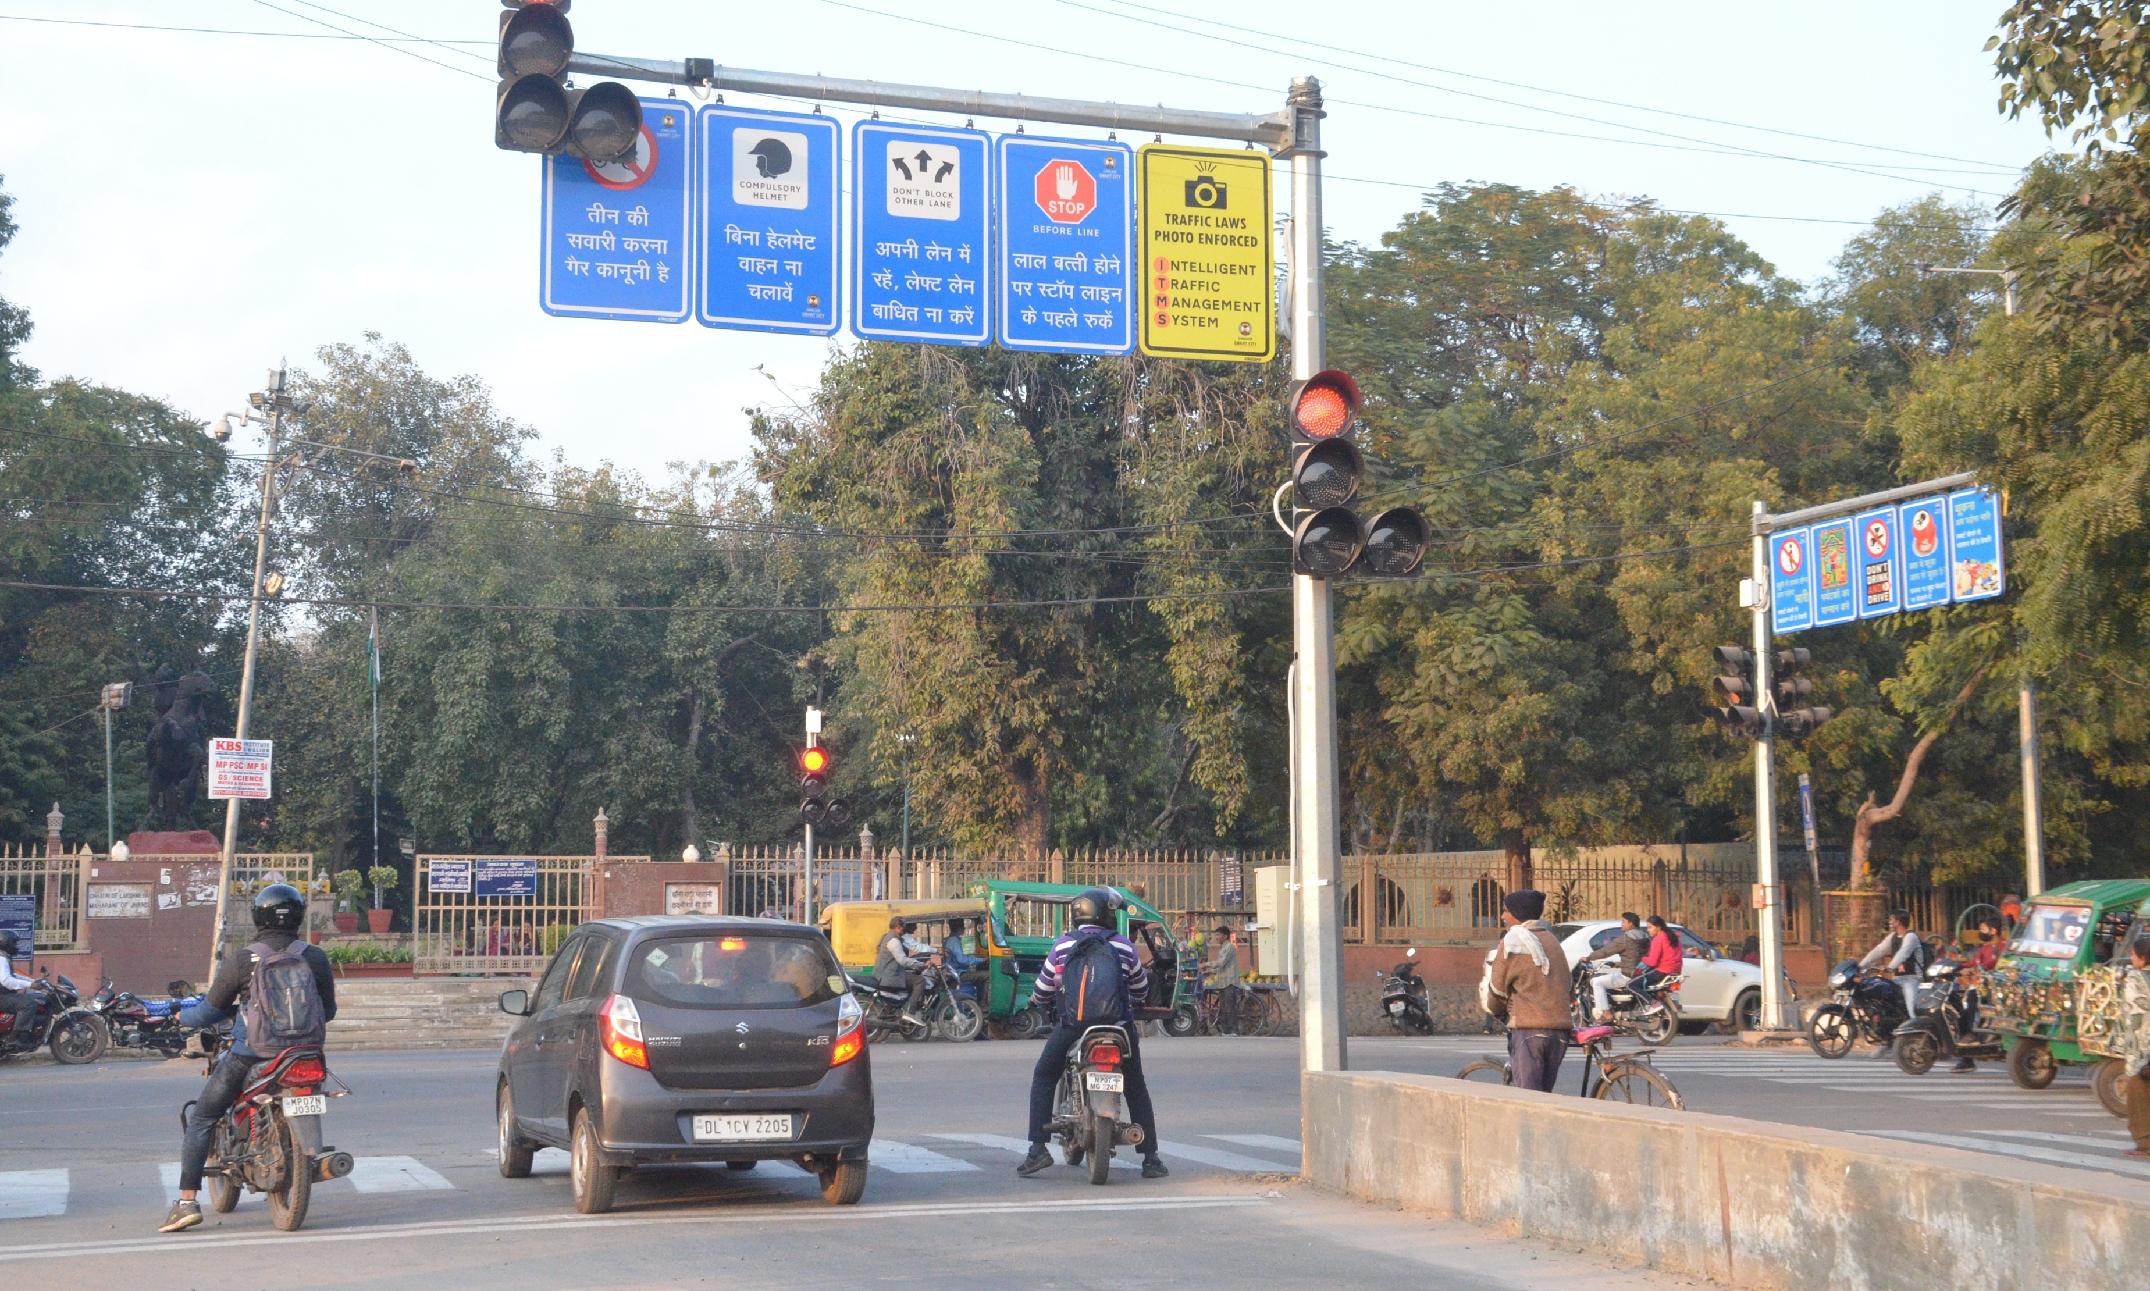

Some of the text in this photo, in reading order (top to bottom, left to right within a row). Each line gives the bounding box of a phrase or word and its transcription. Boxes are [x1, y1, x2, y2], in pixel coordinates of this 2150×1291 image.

[739, 181, 801, 193] COMPULSORY
[893, 187, 953, 198] DON'T BLOCK
[753, 192, 788, 201] HELMET
[895, 197, 952, 208] OTHER LANE
[586, 202, 650, 227] तीन की
[1048, 200, 1085, 215] STOP
[1165, 213, 1247, 230] TRAFFIC LAWS
[723, 223, 817, 250] बिना हेलमेट
[1033, 224, 1100, 238] BEFORE LINE
[1154, 230, 1258, 248] PHOTO ENFORCED
[566, 230, 668, 255] सवारी करना
[875, 238, 971, 264] अपनी लेन में
[564, 255, 670, 285] गैर कानूनी है
[737, 256, 803, 276] वाहन ना
[1012, 251, 1121, 275] लाल बत्ती होने
[1159, 259, 1257, 276] INTELLIGENT
[871, 267, 975, 295] रहें, लेफ्ट लेन
[1157, 277, 1221, 293] TRAFFIC
[746, 281, 793, 302] चलावें
[1010, 279, 1123, 304] पर स्टॉप लाइन
[871, 299, 975, 325] बाधित ना करें
[1156, 296, 1262, 313] MANAGEMENT
[1020, 305, 1113, 329] के पहले रुकें
[1157, 314, 1219, 329] SYSTEM
[215, 740, 242, 752] KBS
[229, 762, 244, 770] PSC
[705, 1120, 721, 1134] DL
[755, 1119, 789, 1133] 2205
